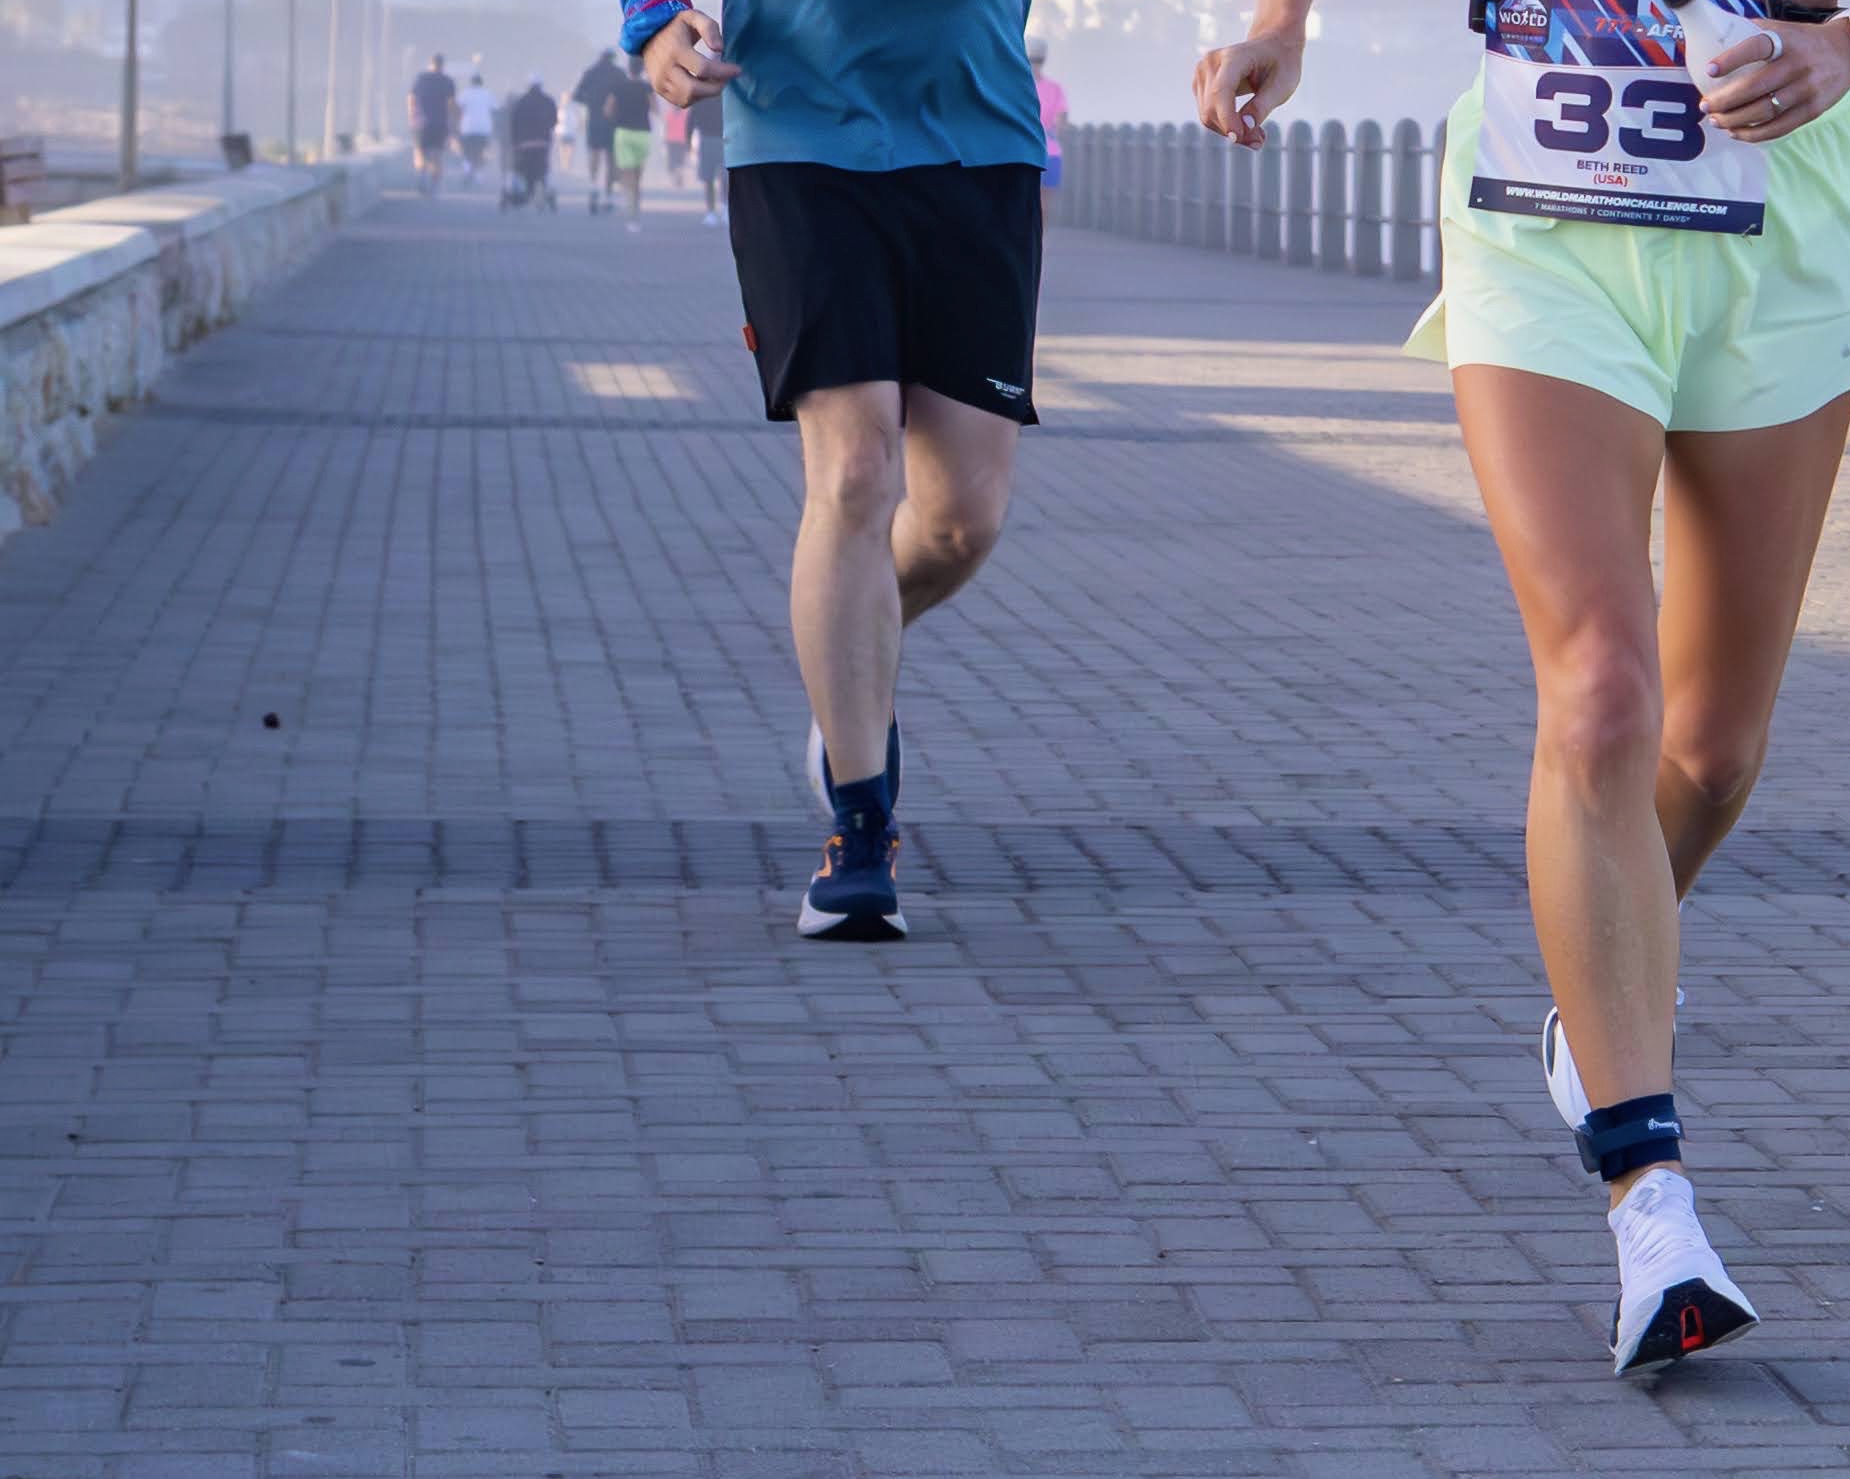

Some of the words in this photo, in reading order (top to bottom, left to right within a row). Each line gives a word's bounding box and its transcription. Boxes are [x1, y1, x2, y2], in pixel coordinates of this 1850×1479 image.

[1646, 23, 1684, 39] AFR
[1534, 71, 1706, 161] 33
[1576, 159, 1609, 172] BETH
[1613, 162, 1648, 175] REED
[1593, 173, 1628, 187] (USA)
[1505, 185, 1728, 215] WWW.WORLDMARATHONCHALLENGE.COM
[1540, 203, 1588, 215] MARATHONS
[1596, 209, 1653, 220] CONTINENTS
